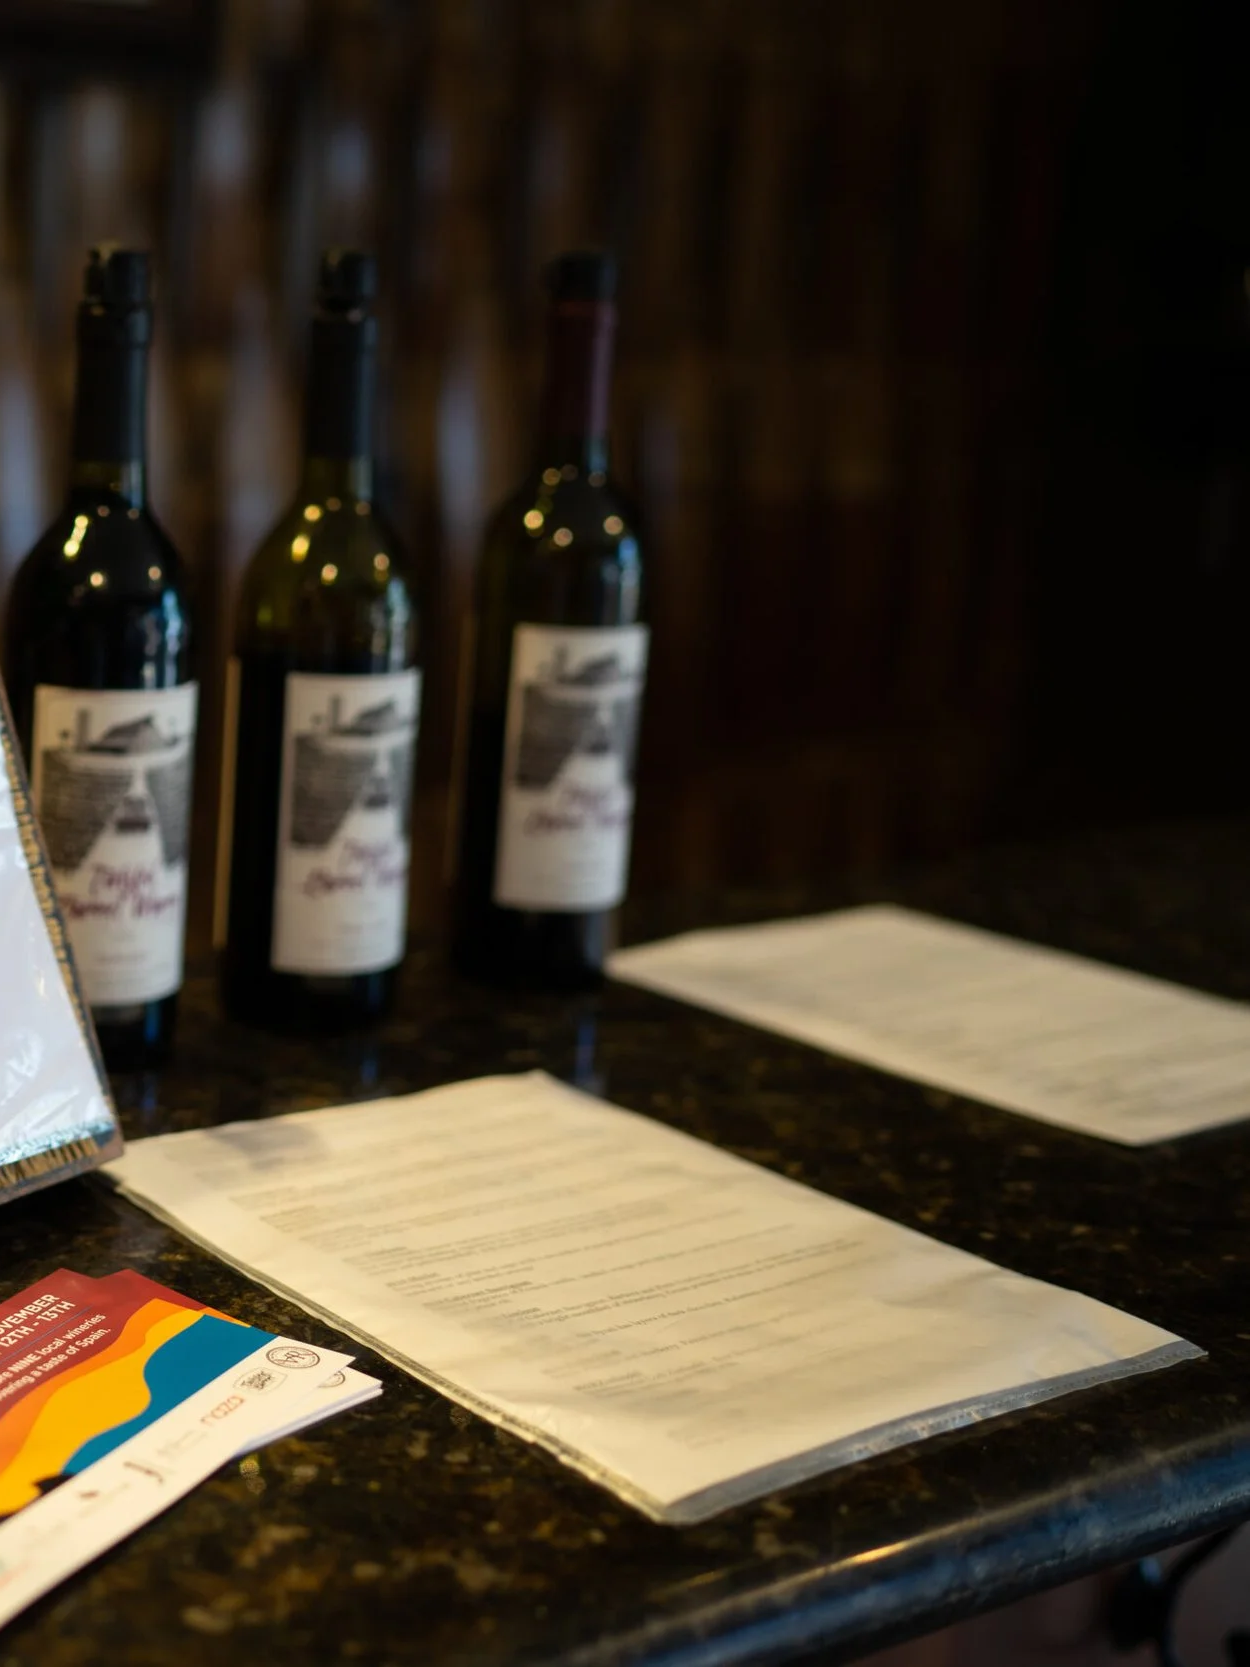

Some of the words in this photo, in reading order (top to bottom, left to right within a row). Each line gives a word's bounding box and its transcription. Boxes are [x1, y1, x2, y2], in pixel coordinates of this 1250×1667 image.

[36, 1300, 76, 1321] 13TH
[7, 1353, 42, 1373] NINE
[34, 1337, 67, 1356] local
[62, 1313, 107, 1340] wineries
[36, 1353, 68, 1372] taste
[65, 1344, 81, 1356] of
[75, 1328, 111, 1348] Spain.
